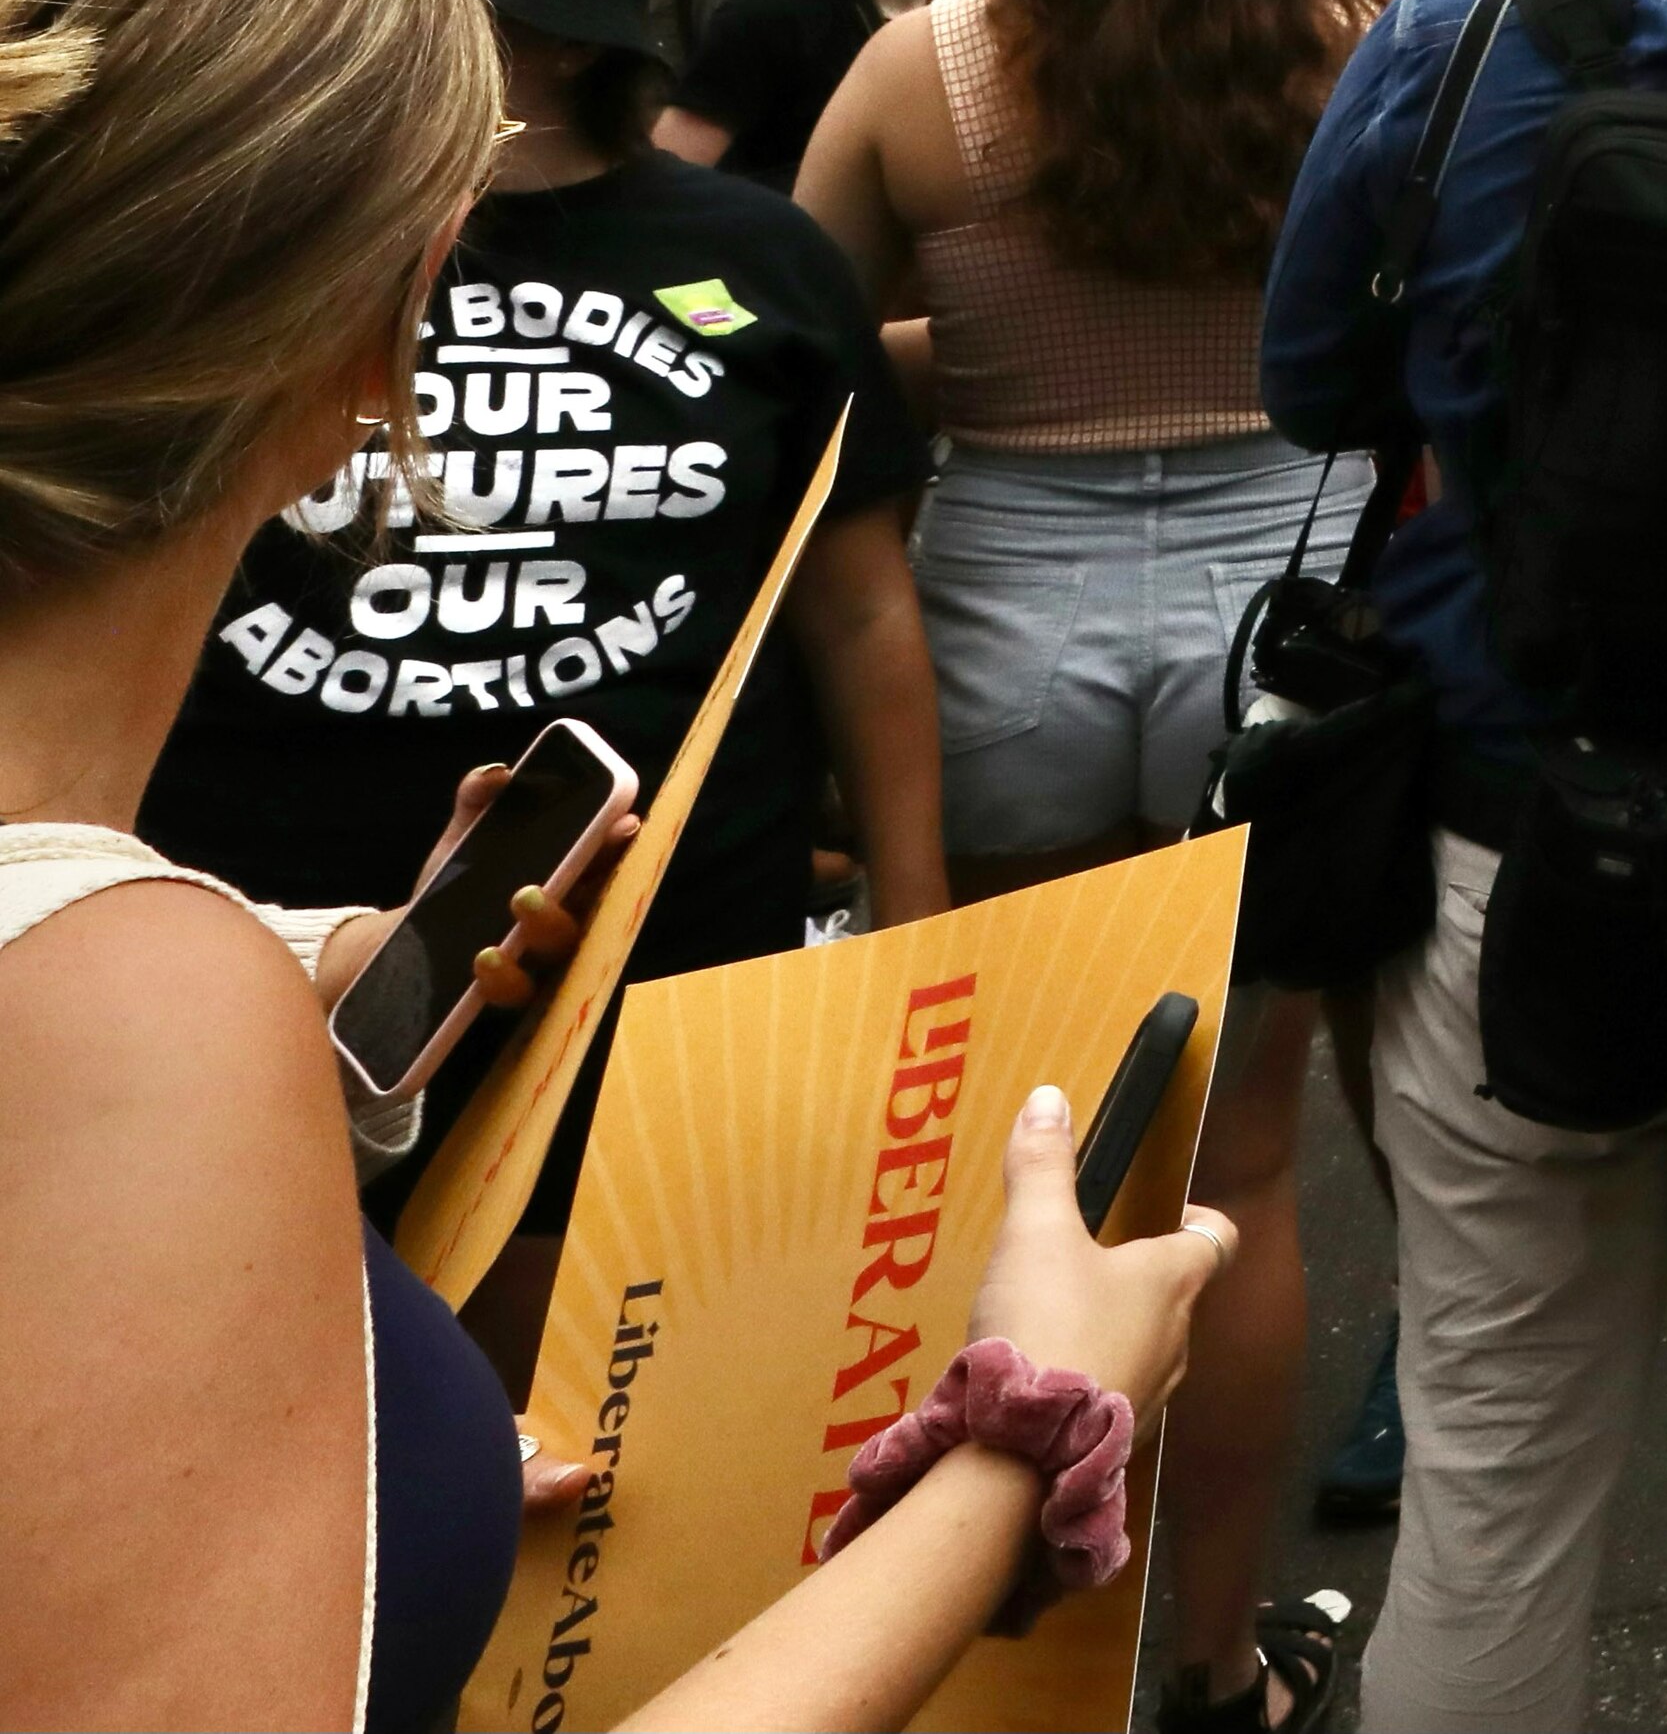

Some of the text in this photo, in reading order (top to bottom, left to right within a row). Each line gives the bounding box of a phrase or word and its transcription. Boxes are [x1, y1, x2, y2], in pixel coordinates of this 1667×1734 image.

[449, 281, 727, 399] BODIES
[280, 440, 729, 535] UTURES
[217, 573, 699, 718] ABORTIONS
[350, 559, 589, 641] OUR
